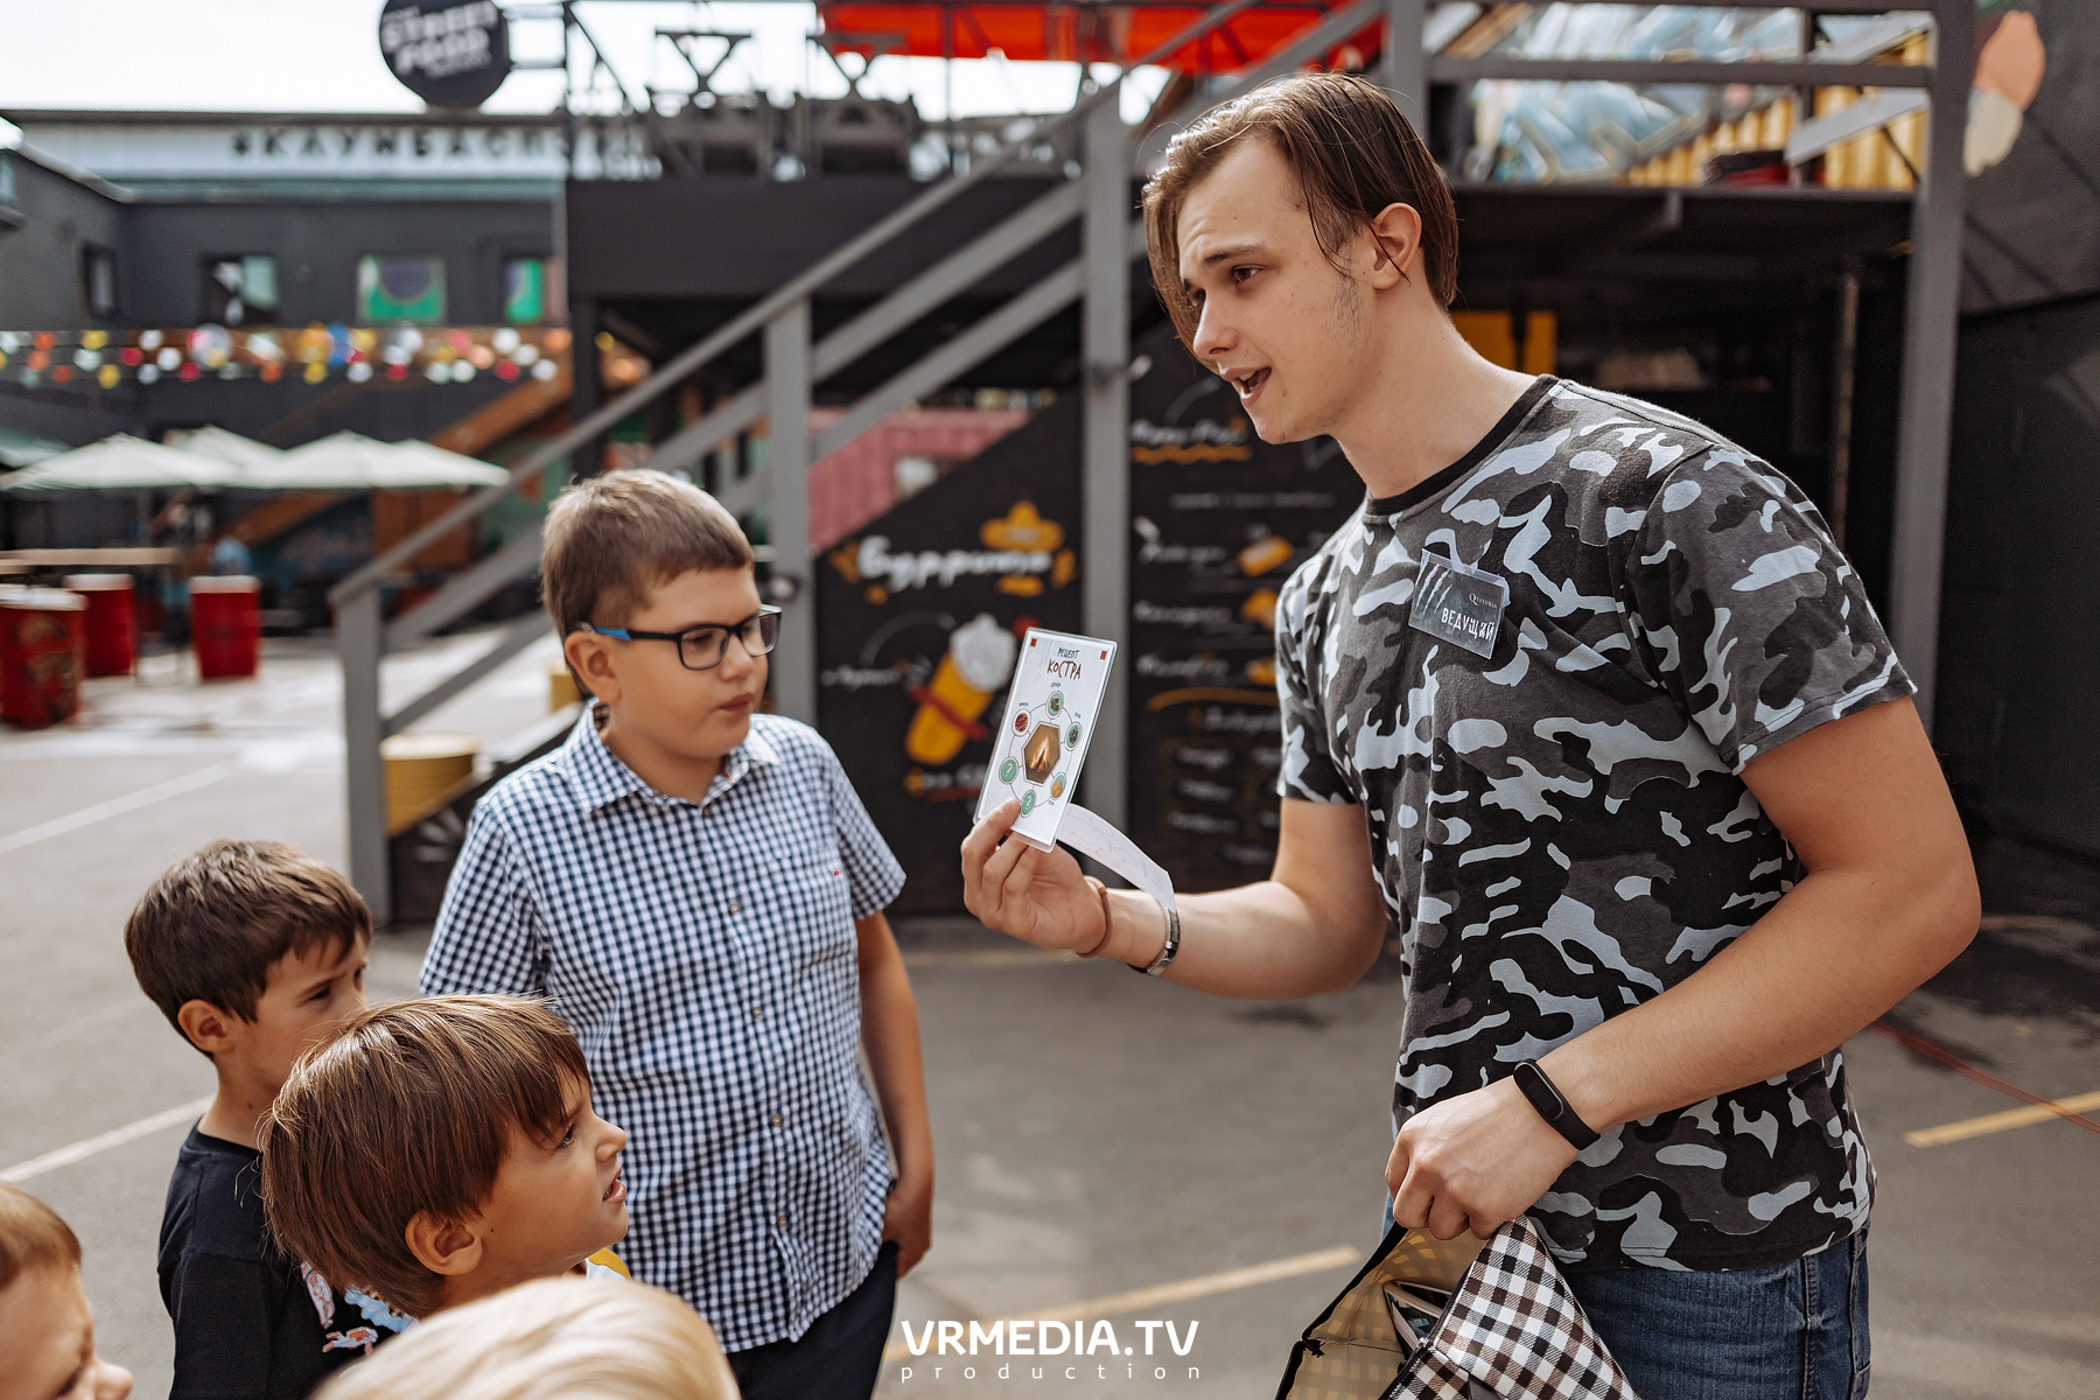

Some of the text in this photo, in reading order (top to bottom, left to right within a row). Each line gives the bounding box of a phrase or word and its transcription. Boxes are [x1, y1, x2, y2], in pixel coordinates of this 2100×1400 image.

[381, 1, 498, 53] STREET
[1441, 607, 1495, 641] ВЕДУЩИЙ
[1057, 647, 1080, 660] РЕЦЕПТ
[1047, 658, 1082, 680] КОСТРА
